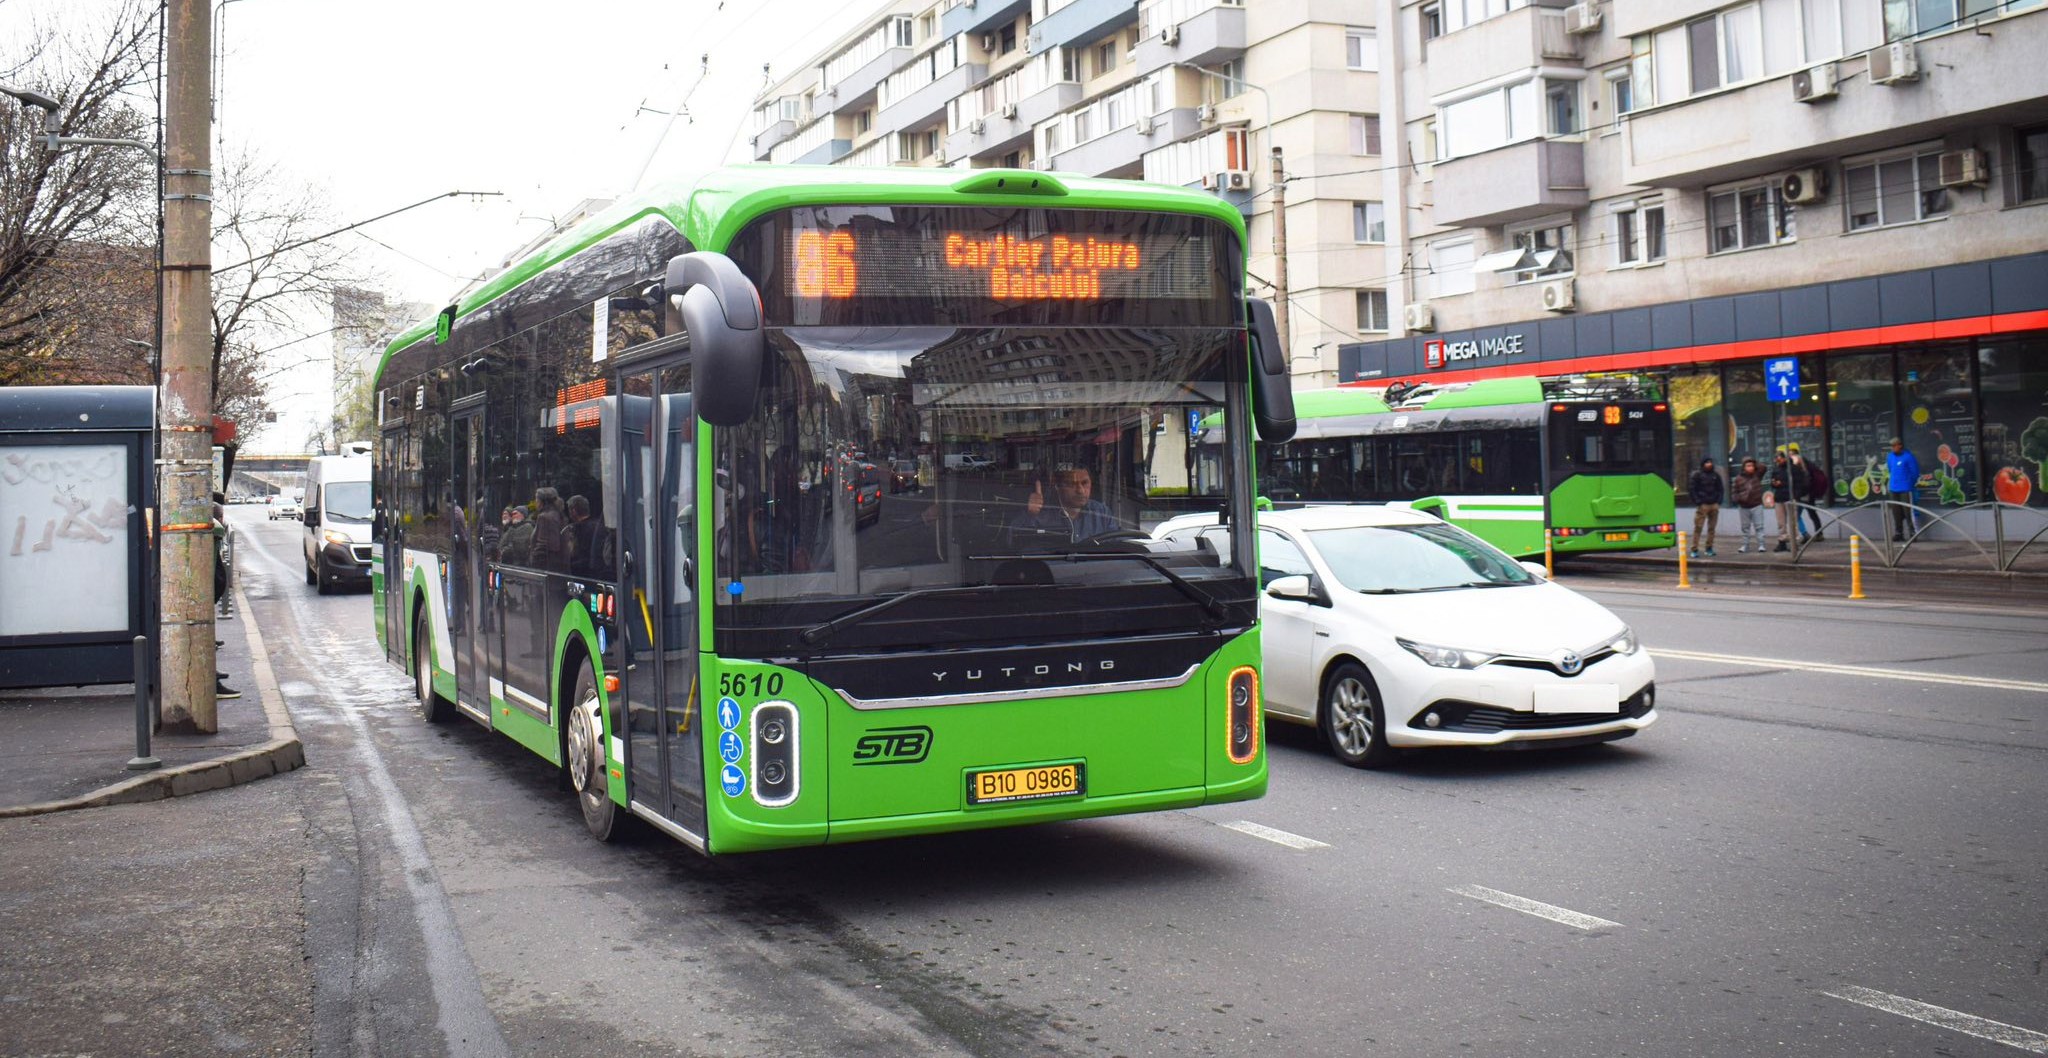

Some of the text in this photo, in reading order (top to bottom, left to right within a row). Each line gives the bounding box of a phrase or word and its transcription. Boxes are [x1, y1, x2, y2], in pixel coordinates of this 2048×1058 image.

[797, 231, 856, 298] 86
[946, 233, 1140, 269] Cartier Pajura
[991, 267, 1100, 298] Baicului
[1443, 334, 1523, 361] MEGA IMAGE
[720, 672, 784, 697] 5610
[932, 660, 1115, 682] YUTONG
[853, 731, 927, 760] STB
[982, 768, 1072, 795] B10 0986
